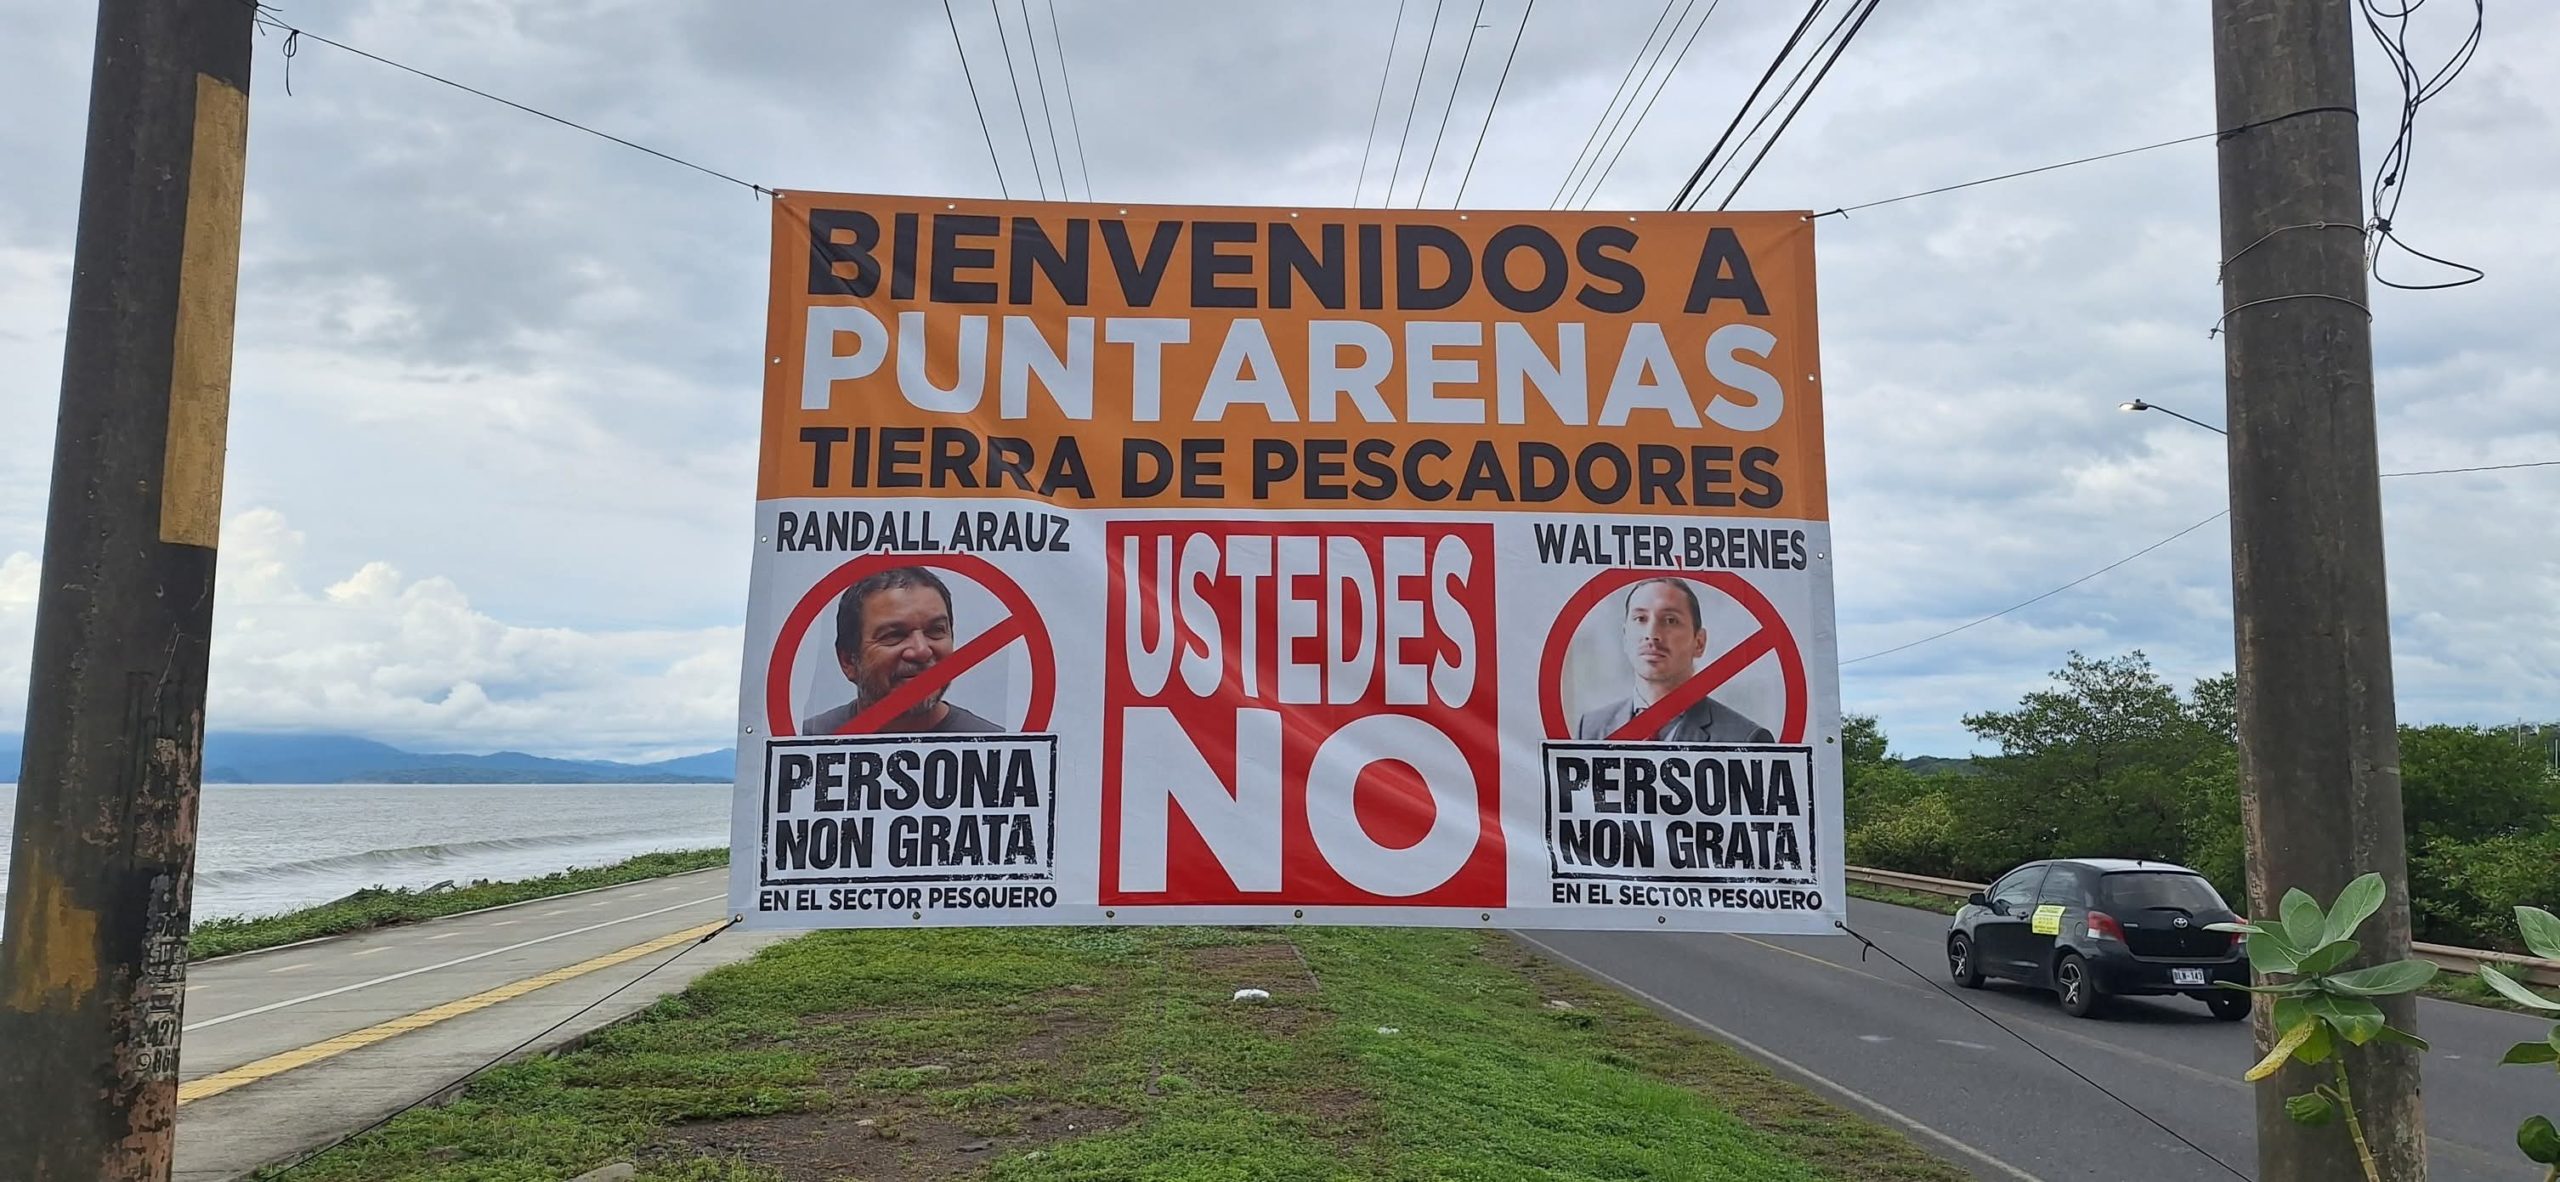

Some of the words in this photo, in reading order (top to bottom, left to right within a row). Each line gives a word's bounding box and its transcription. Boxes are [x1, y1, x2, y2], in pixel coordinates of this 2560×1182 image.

[807, 207, 1645, 313] BIENVENIDOS
[1684, 227, 1771, 315] A
[800, 306, 1784, 432] PUNTARENAS
[800, 426, 1095, 500] TIERRA
[1121, 437, 1226, 499] DE
[1252, 439, 1782, 509] PESCADORES
[776, 511, 939, 552] RANDALL
[949, 512, 1070, 552] ARAUZ
[1534, 523, 1674, 567] WALTER
[1680, 527, 1807, 570] BRENES
[1123, 532, 1477, 709] USTEDES
[777, 749, 1039, 813] PERSONA
[1118, 706, 1481, 897] NO
[1555, 757, 1800, 816] PERSONA
[775, 817, 875, 870] NON
[888, 815, 1037, 868] GRATA
[1558, 819, 1654, 869] NON
[1665, 820, 1802, 871] GRATA
[759, 891, 789, 911] EN
[796, 890, 823, 911] EL
[829, 888, 922, 911] SECTOR
[929, 887, 1058, 910] PESQUERO
[1552, 883, 1581, 904] EN
[1588, 885, 1613, 904] EL
[1619, 886, 1703, 908] SECTOR
[1709, 890, 1823, 910] PESQUERO
